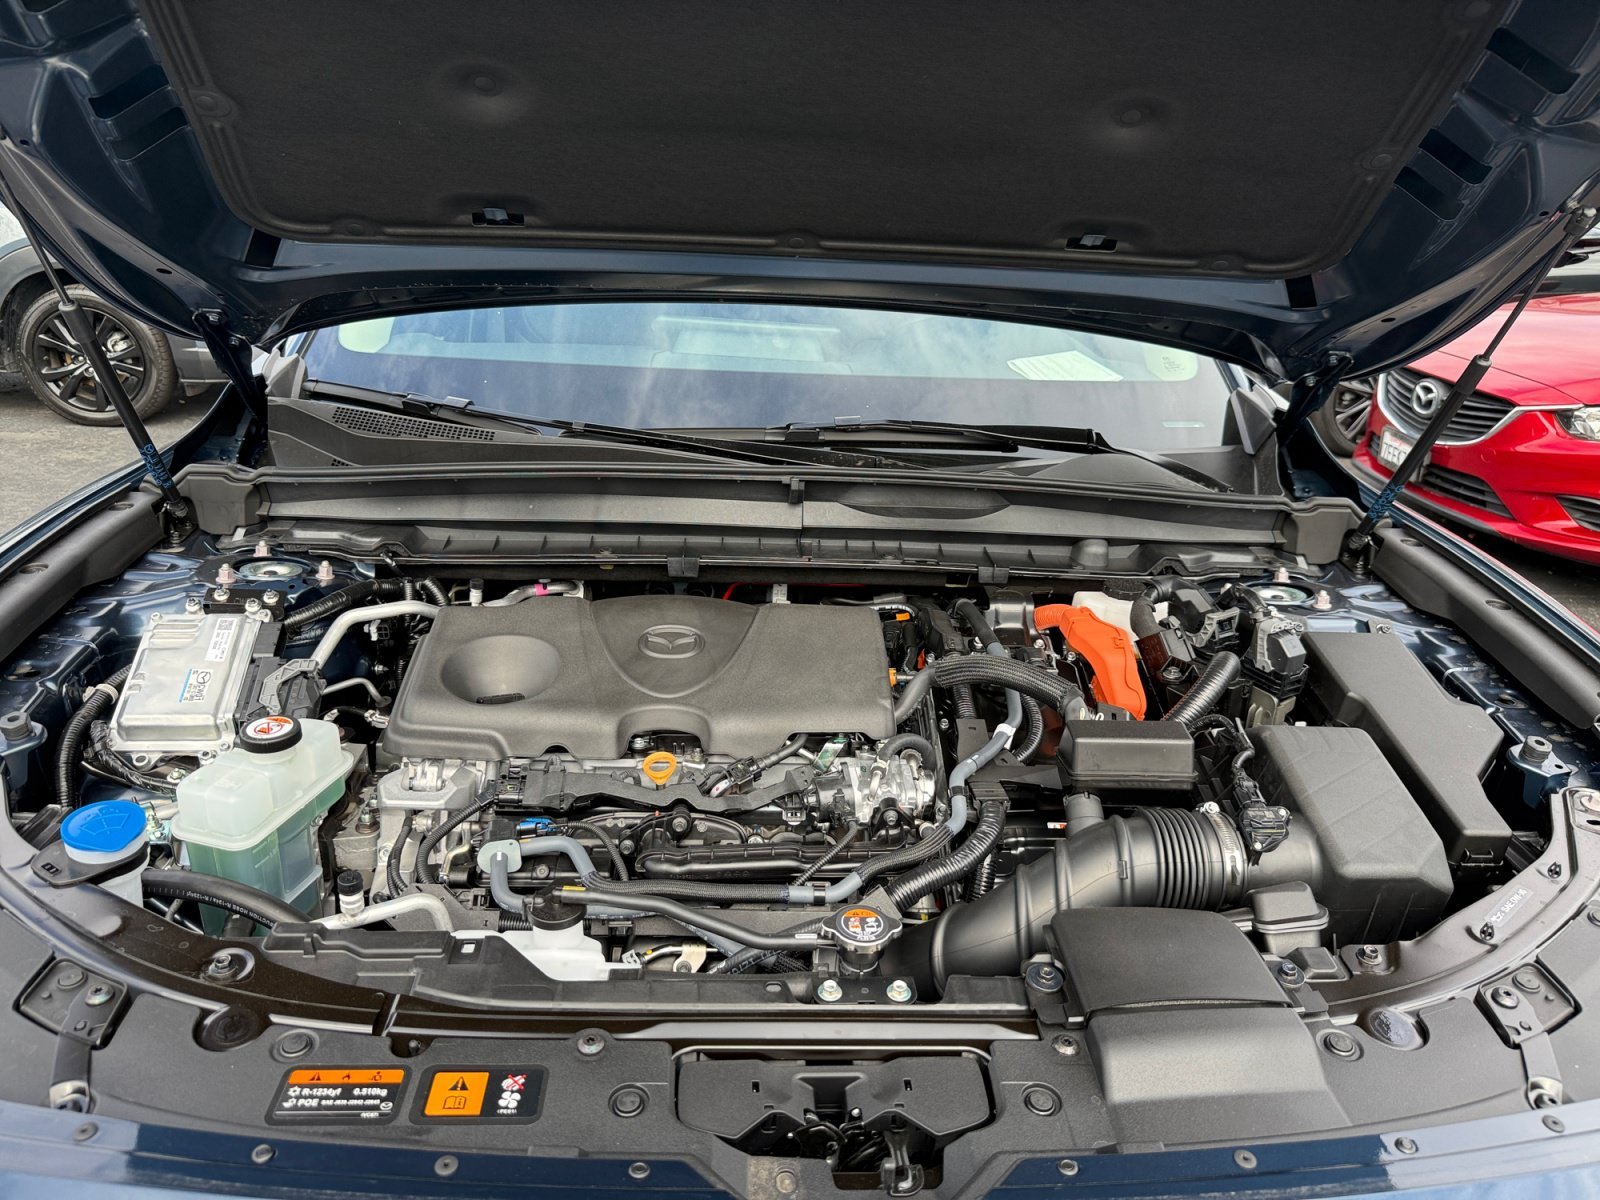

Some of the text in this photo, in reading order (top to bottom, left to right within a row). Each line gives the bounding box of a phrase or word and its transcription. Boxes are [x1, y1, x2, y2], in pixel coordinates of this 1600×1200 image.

[232, 903, 249, 915] HOSE
[301, 1087, 389, 1098] R-1234yf 0.510kg
[297, 1098, 320, 1107] POE
